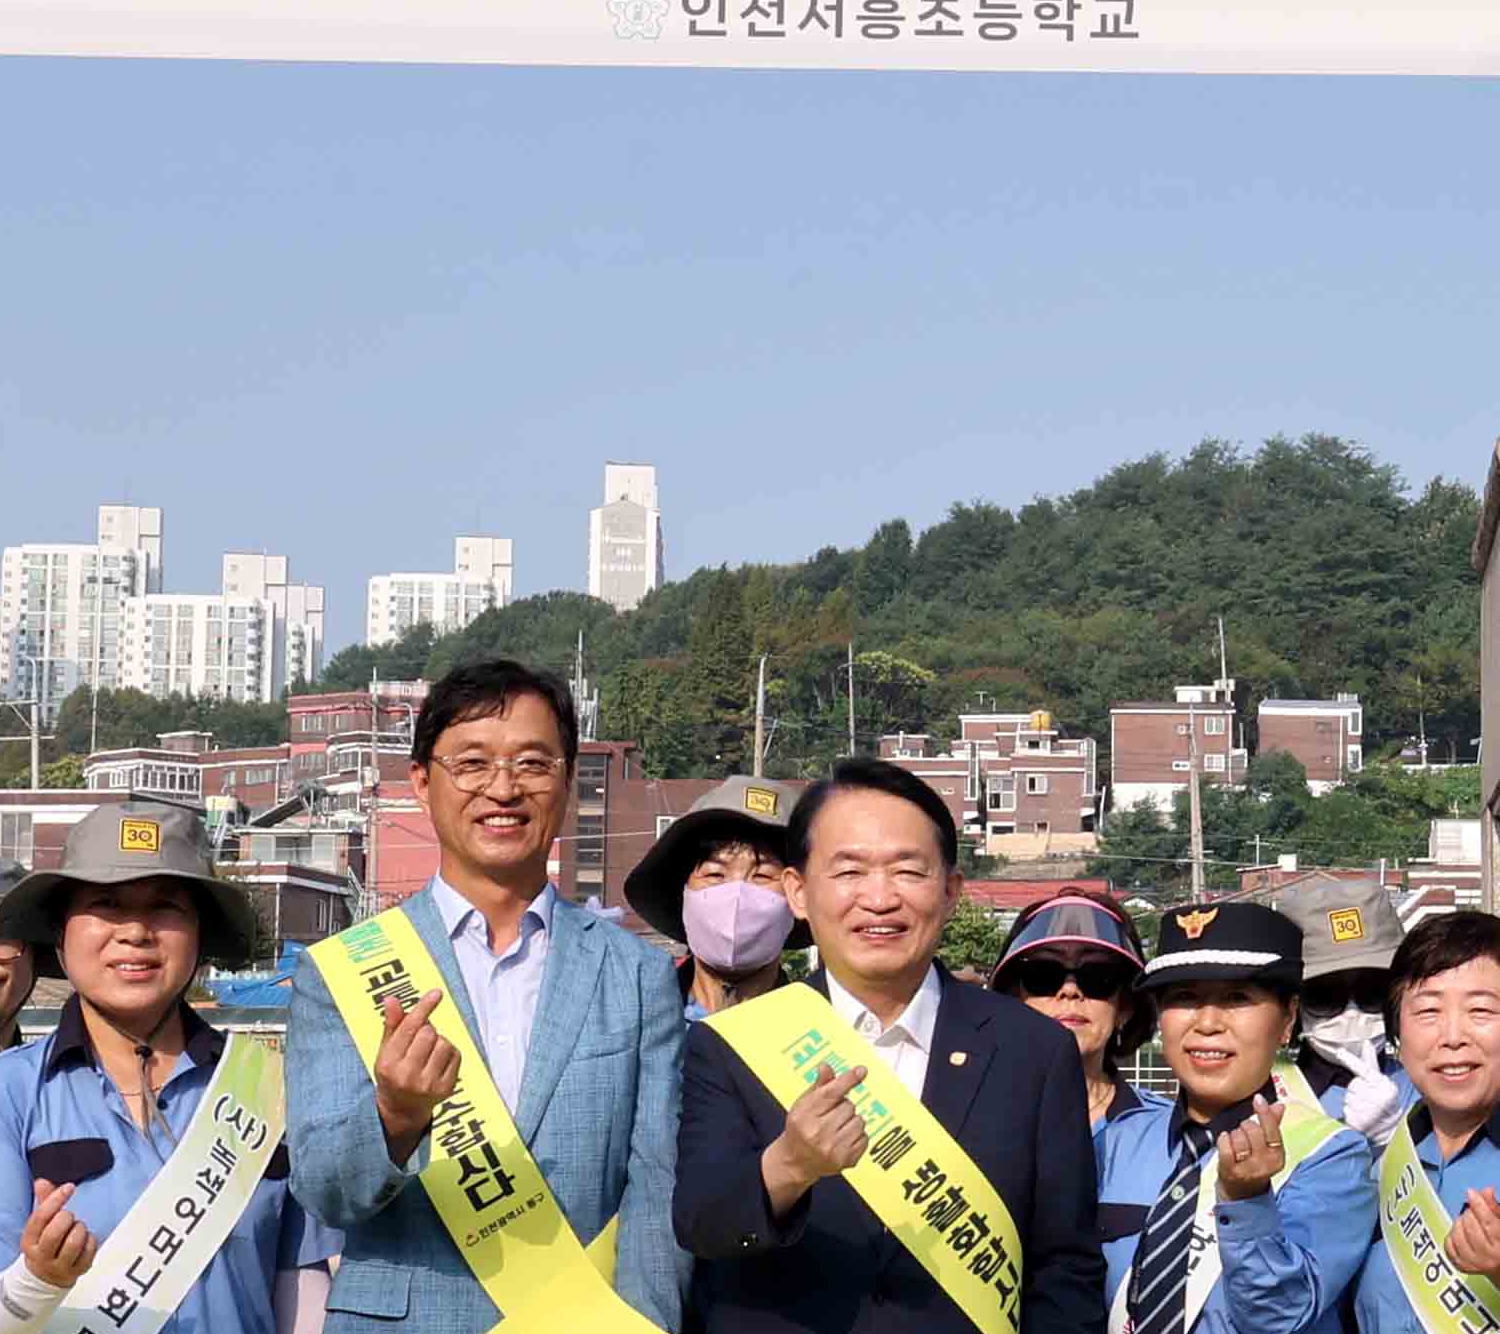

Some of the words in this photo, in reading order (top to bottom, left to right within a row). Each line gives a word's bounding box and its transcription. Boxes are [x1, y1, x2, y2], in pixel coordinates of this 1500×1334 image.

[210, 1092, 269, 1153] (사)
[430, 1077, 518, 1213] 수합시다
[96, 1136, 241, 1330] 녹색어머니회
[901, 1157, 1023, 1333] 생활화합시
[1384, 1161, 1417, 1223] (사)
